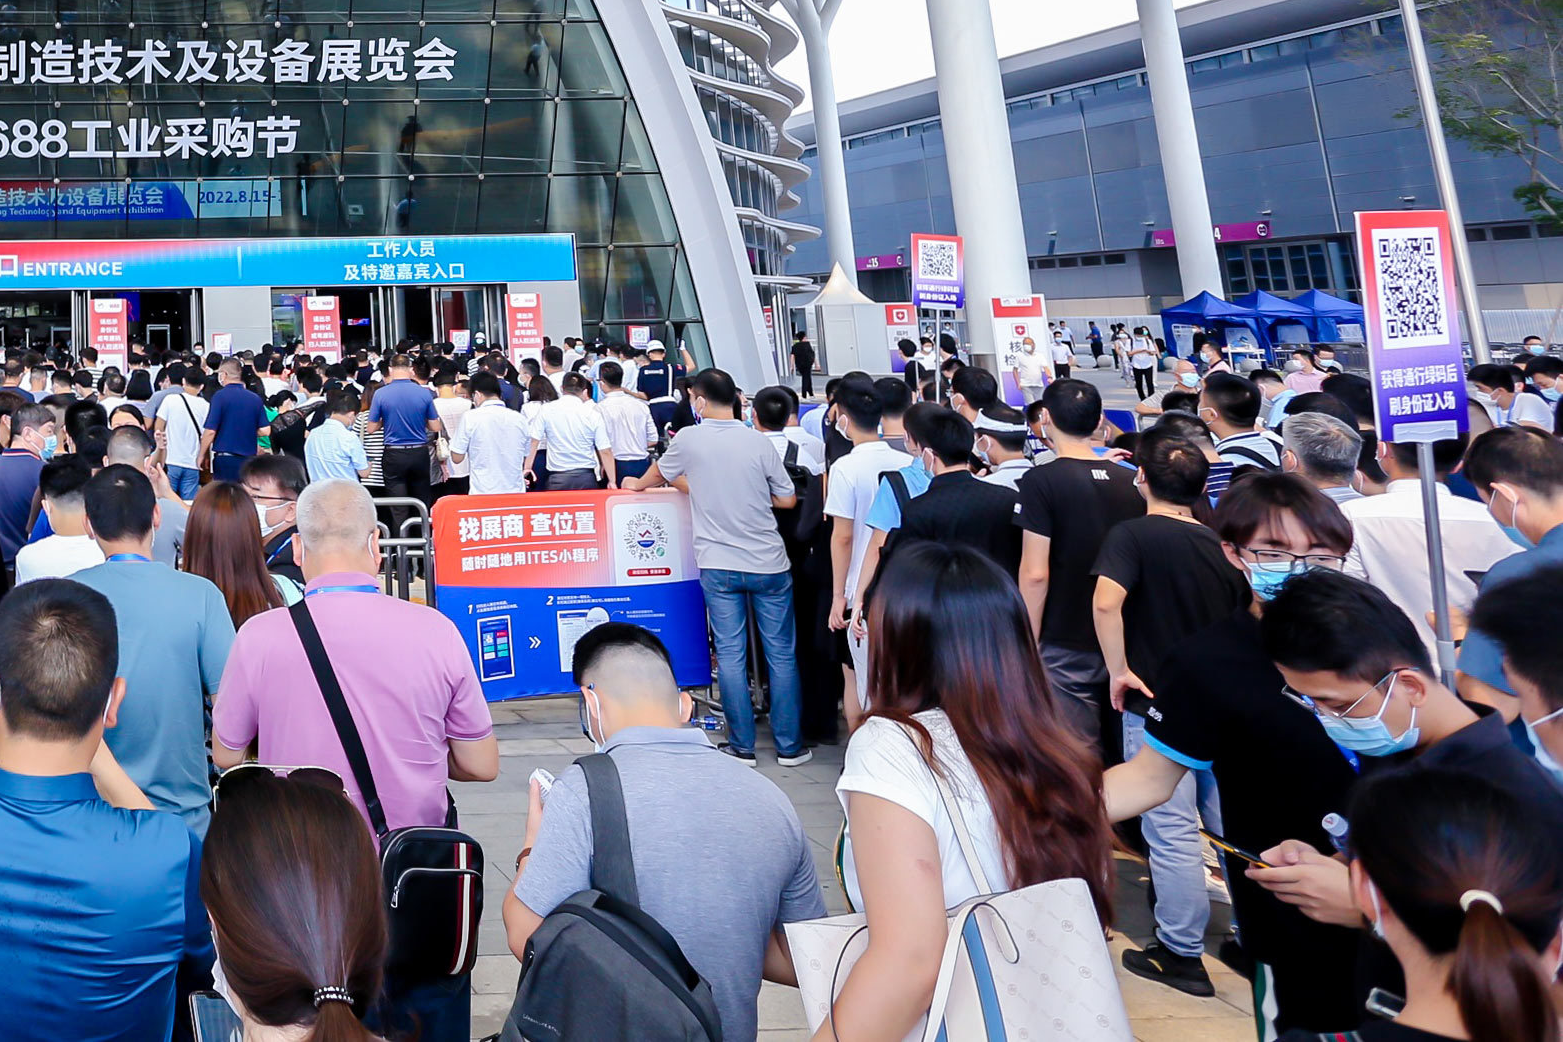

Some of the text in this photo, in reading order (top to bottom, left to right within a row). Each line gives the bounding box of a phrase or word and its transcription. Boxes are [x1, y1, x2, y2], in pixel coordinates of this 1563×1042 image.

[367, 240, 435, 258] 工作人员
[23, 261, 123, 277] ENTRANCE
[344, 262, 465, 281] 及特邀嘉宾入口
[1380, 363, 1459, 389] 获得通行绿码后
[1388, 390, 1456, 416] 刷身份证入场
[459, 511, 597, 542] 找展商 查位置
[461, 548, 599, 572] 随时随地用ITES小程序
[467, 604, 474, 614] 1
[546, 596, 554, 606] 2
